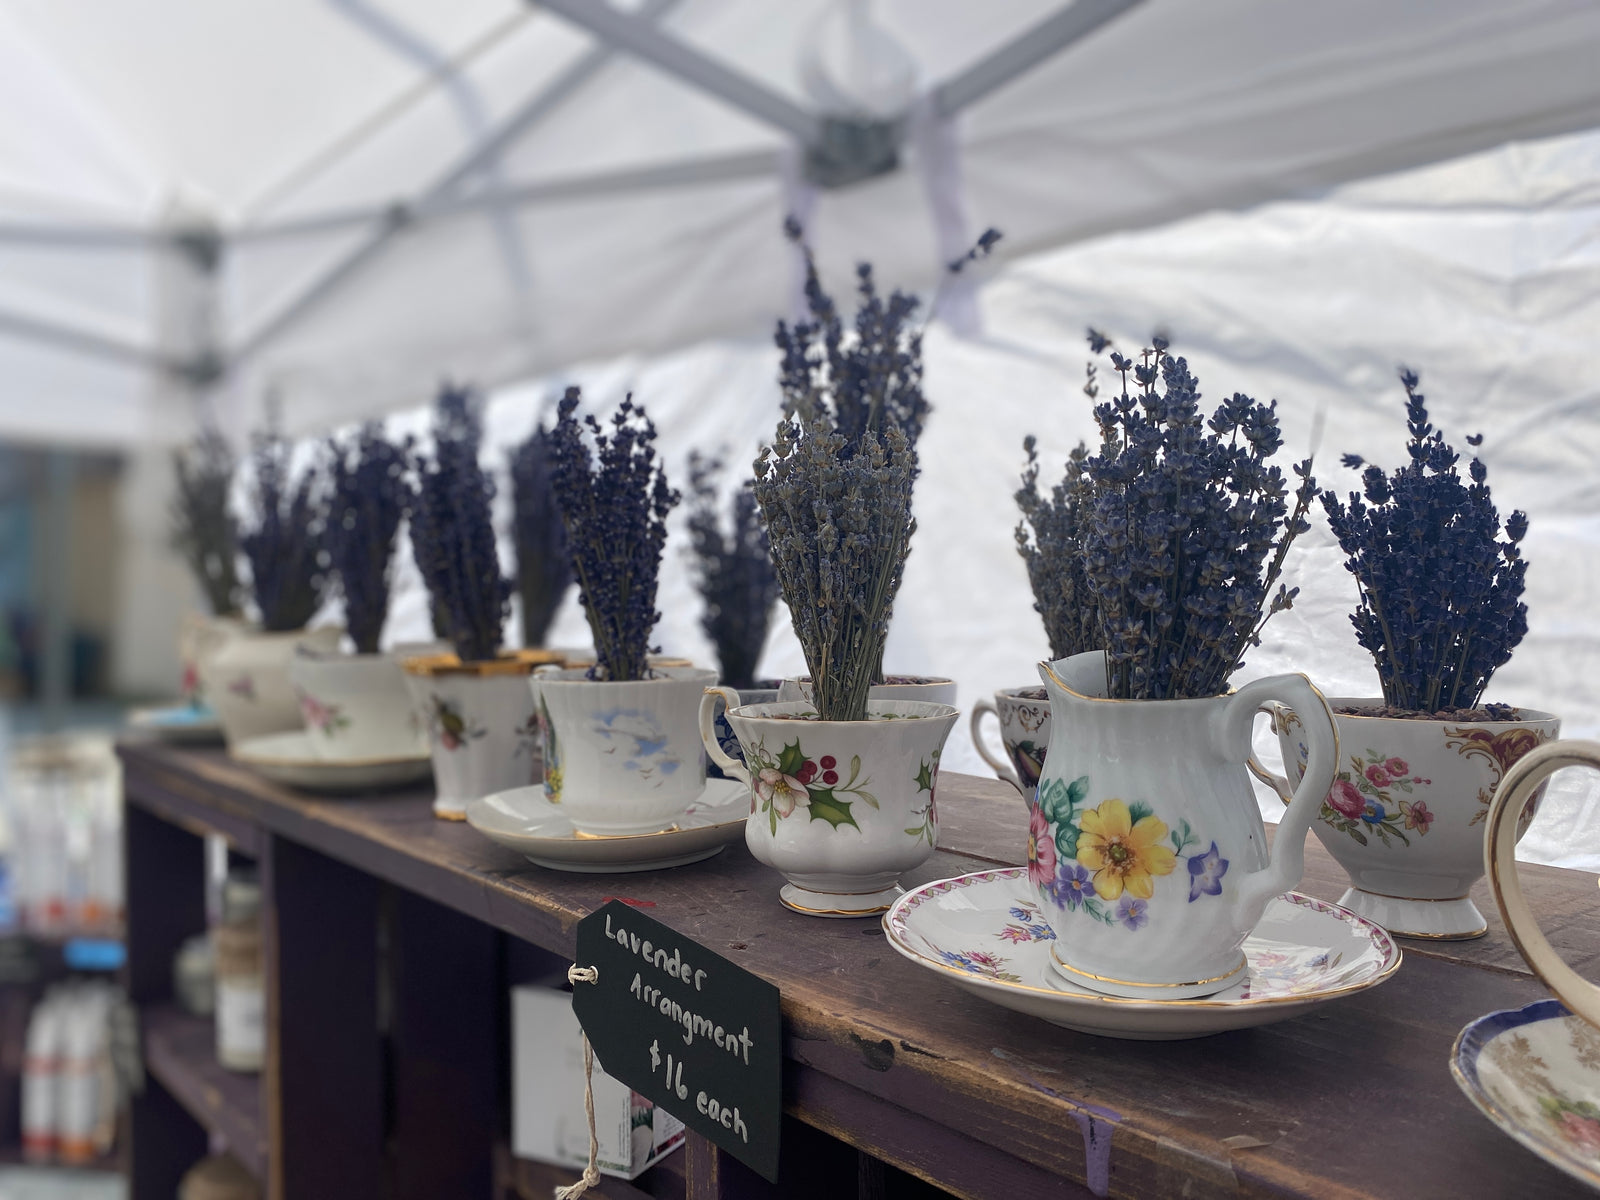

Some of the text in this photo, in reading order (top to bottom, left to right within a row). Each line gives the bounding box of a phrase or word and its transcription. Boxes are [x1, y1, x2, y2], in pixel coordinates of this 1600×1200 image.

[604, 914, 707, 991] Lavender
[630, 972, 753, 1065] Arrangment
[650, 1040, 688, 1100] $16
[696, 1090, 748, 1143] each
